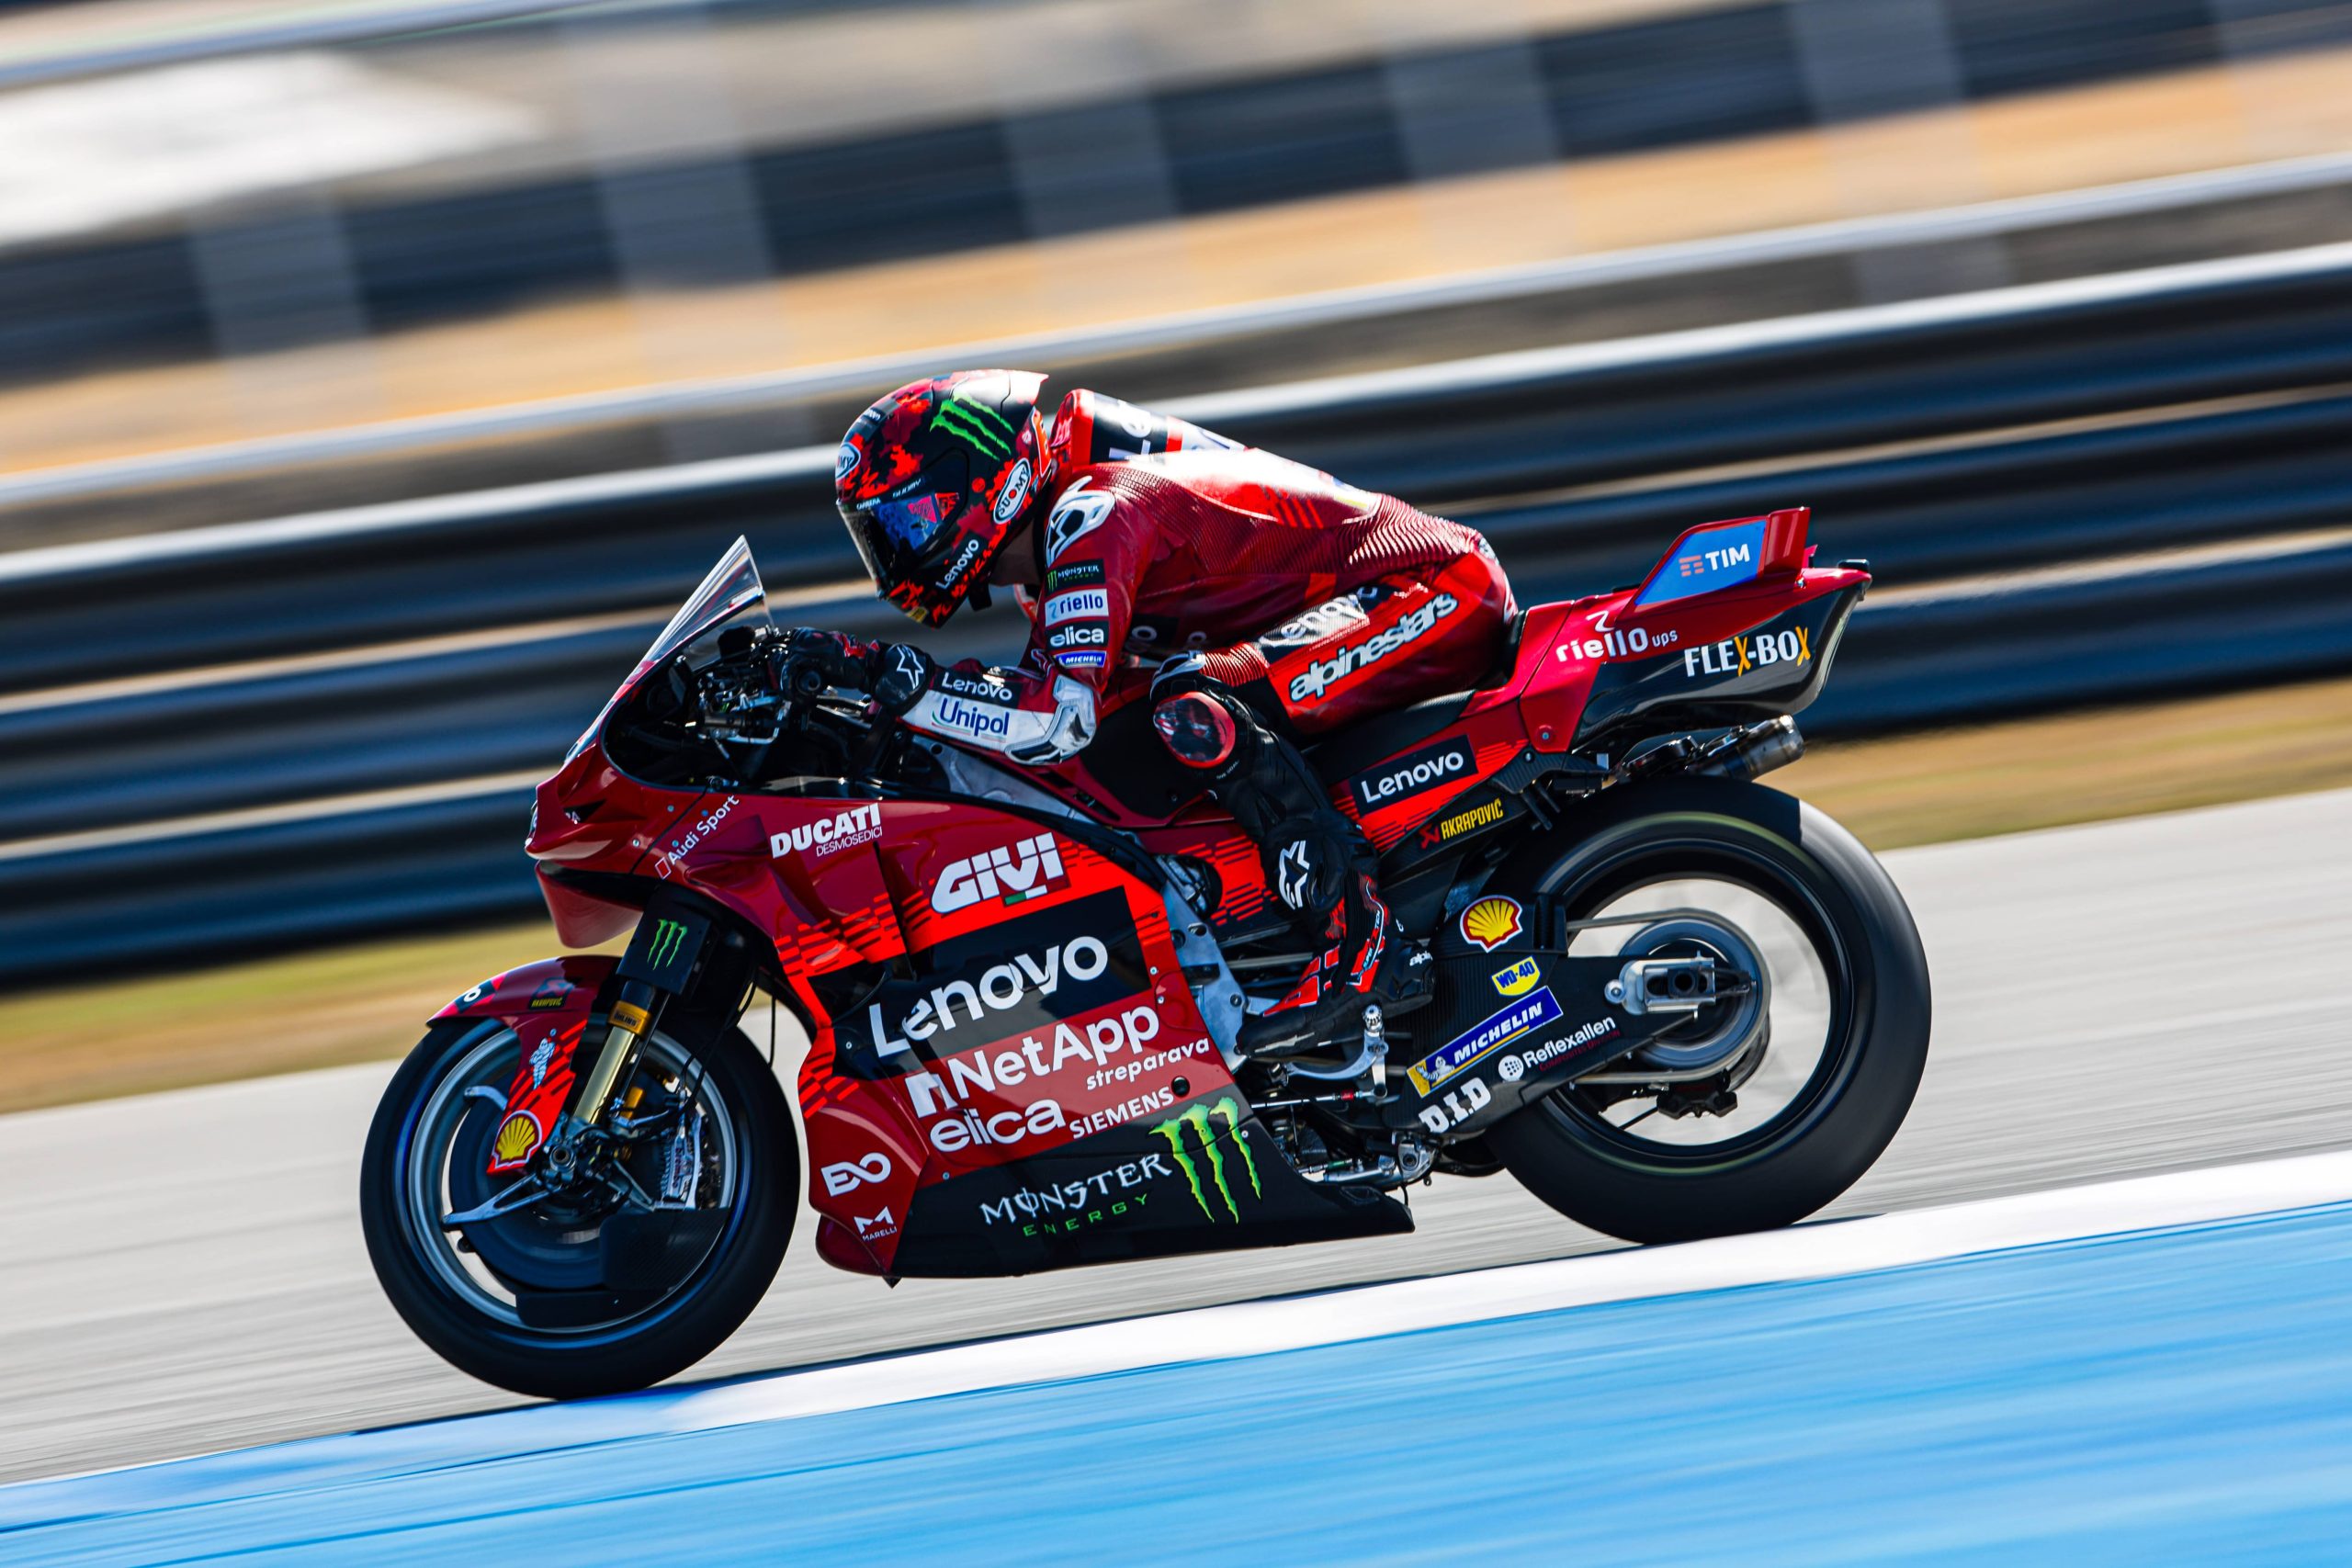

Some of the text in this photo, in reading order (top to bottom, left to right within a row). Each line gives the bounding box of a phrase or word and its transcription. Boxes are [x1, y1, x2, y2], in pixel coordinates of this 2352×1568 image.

[935, 538, 979, 590] Lenovo
[1705, 543, 1750, 571] TIM
[1060, 593, 1103, 614] riello
[1050, 626, 1104, 647] elica
[1065, 655, 1102, 664] MICHELIN
[1289, 592, 1459, 703] alpinestars
[1555, 626, 1648, 662] riello
[1683, 626, 1812, 677] FLEX-BOX
[941, 672, 1012, 701] Lenovo
[939, 698, 1010, 737] Unipol
[1360, 750, 1464, 805] Lenovo
[667, 795, 740, 865] Audi Sport
[770, 803, 882, 859] DUCATI
[816, 826, 883, 857] DESMOSEDICI
[931, 832, 1066, 914] GIVI
[868, 935, 1109, 1058] Lenovo
[947, 1005, 1160, 1100] NetApp
[1453, 1001, 1544, 1066] MICHELIN
[1522, 1016, 1617, 1068] Reflexallen
[1086, 1035, 1210, 1091] streparava
[930, 1099, 1066, 1154] elica
[1069, 1088, 1175, 1140] SIEMENS
[1418, 1077, 1492, 1134] D.I.D
[978, 1152, 1173, 1225] MONSTER
[862, 1224, 898, 1243] MARELLI
[1022, 1193, 1148, 1237] ENERGY
